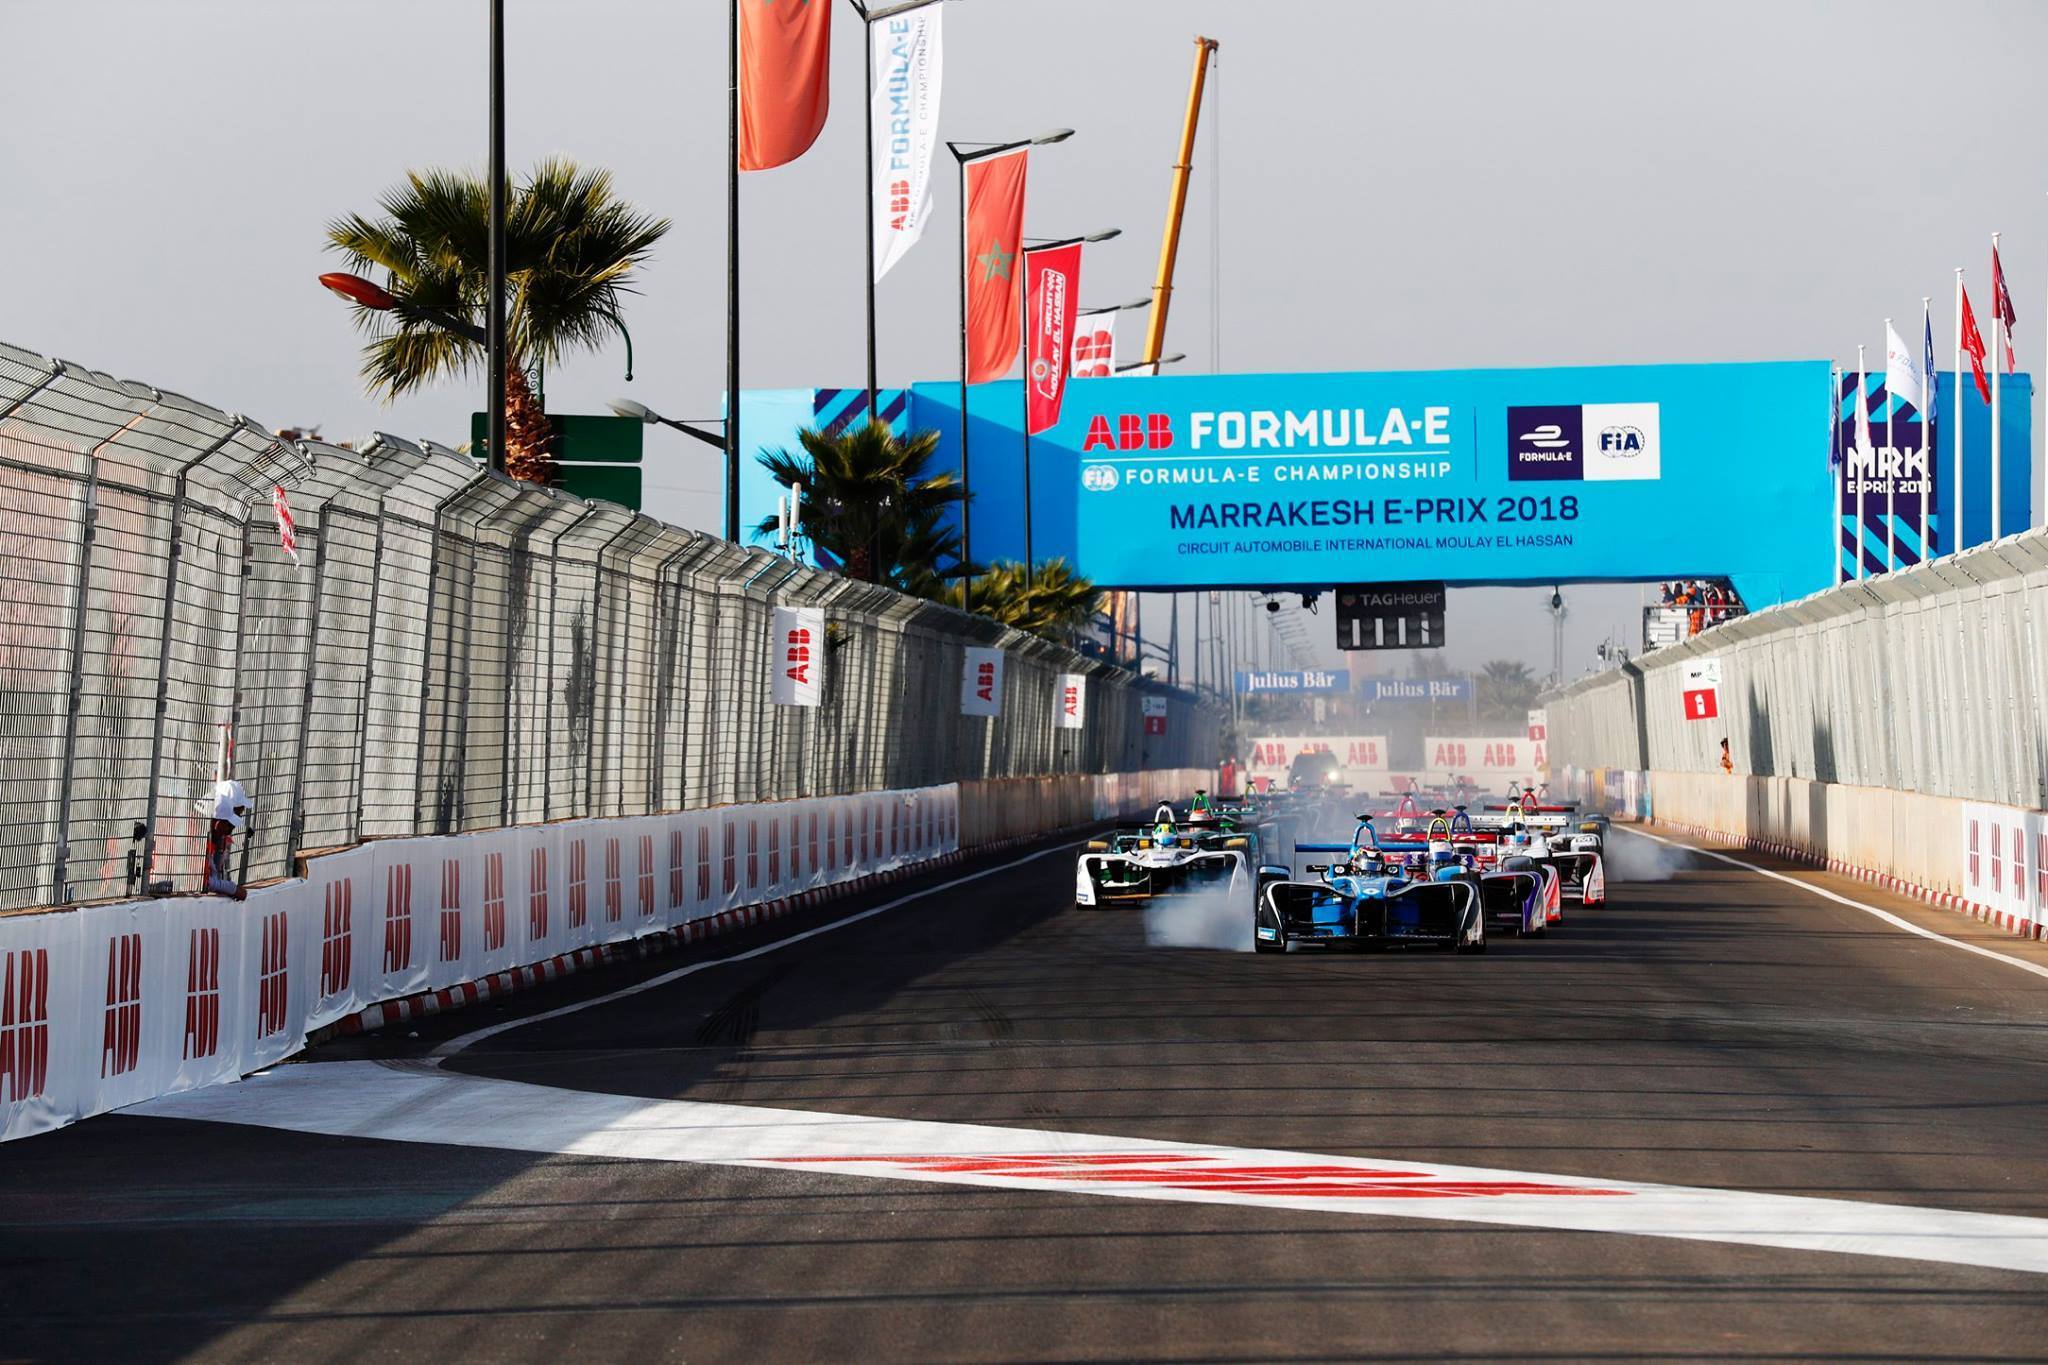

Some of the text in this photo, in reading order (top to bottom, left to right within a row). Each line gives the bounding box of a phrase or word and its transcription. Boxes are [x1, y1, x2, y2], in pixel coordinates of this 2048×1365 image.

[889, 18, 910, 231] ABB FORMULA-E
[1083, 406, 1451, 451] ABB FORMULA-E
[1519, 452, 1572, 462] FORMULA-E
[1126, 462, 1451, 485] FORMULA-E CHAMPIONSHIP
[1847, 446, 1931, 478] MRK
[1170, 495, 1579, 529] MARRAKESH E-PRIX 2018
[1177, 534, 1573, 555] CIRCUIT AUTOMOBILE INTERNATIONAL MOULAY EL HASSAN
[786, 628, 811, 685] ABB
[976, 661, 994, 702] ABB
[1249, 672, 1336, 691] Julius Bär
[1064, 685, 1077, 717] ABB
[1376, 681, 1460, 699] Julius Bär
[1254, 743, 1286, 766] ABB
[1348, 742, 1378, 765] ABB
[1435, 743, 1466, 767] ABB
[1484, 744, 1516, 767] ABB
[569, 839, 586, 929] ABB
[606, 838, 621, 922] ABB
[638, 835, 654, 916] ABB
[1992, 822, 2001, 894] ABB
[2014, 827, 2025, 901] ABB
[383, 864, 411, 974] ABB
[440, 859, 461, 962] ABB
[484, 852, 504, 951] ABB
[530, 847, 548, 941] ABB
[321, 878, 352, 998] ABB
[101, 934, 142, 1079] ABB
[183, 928, 219, 1060] ABB
[258, 911, 287, 1040] ABB
[0, 949, 48, 1102] ABB
